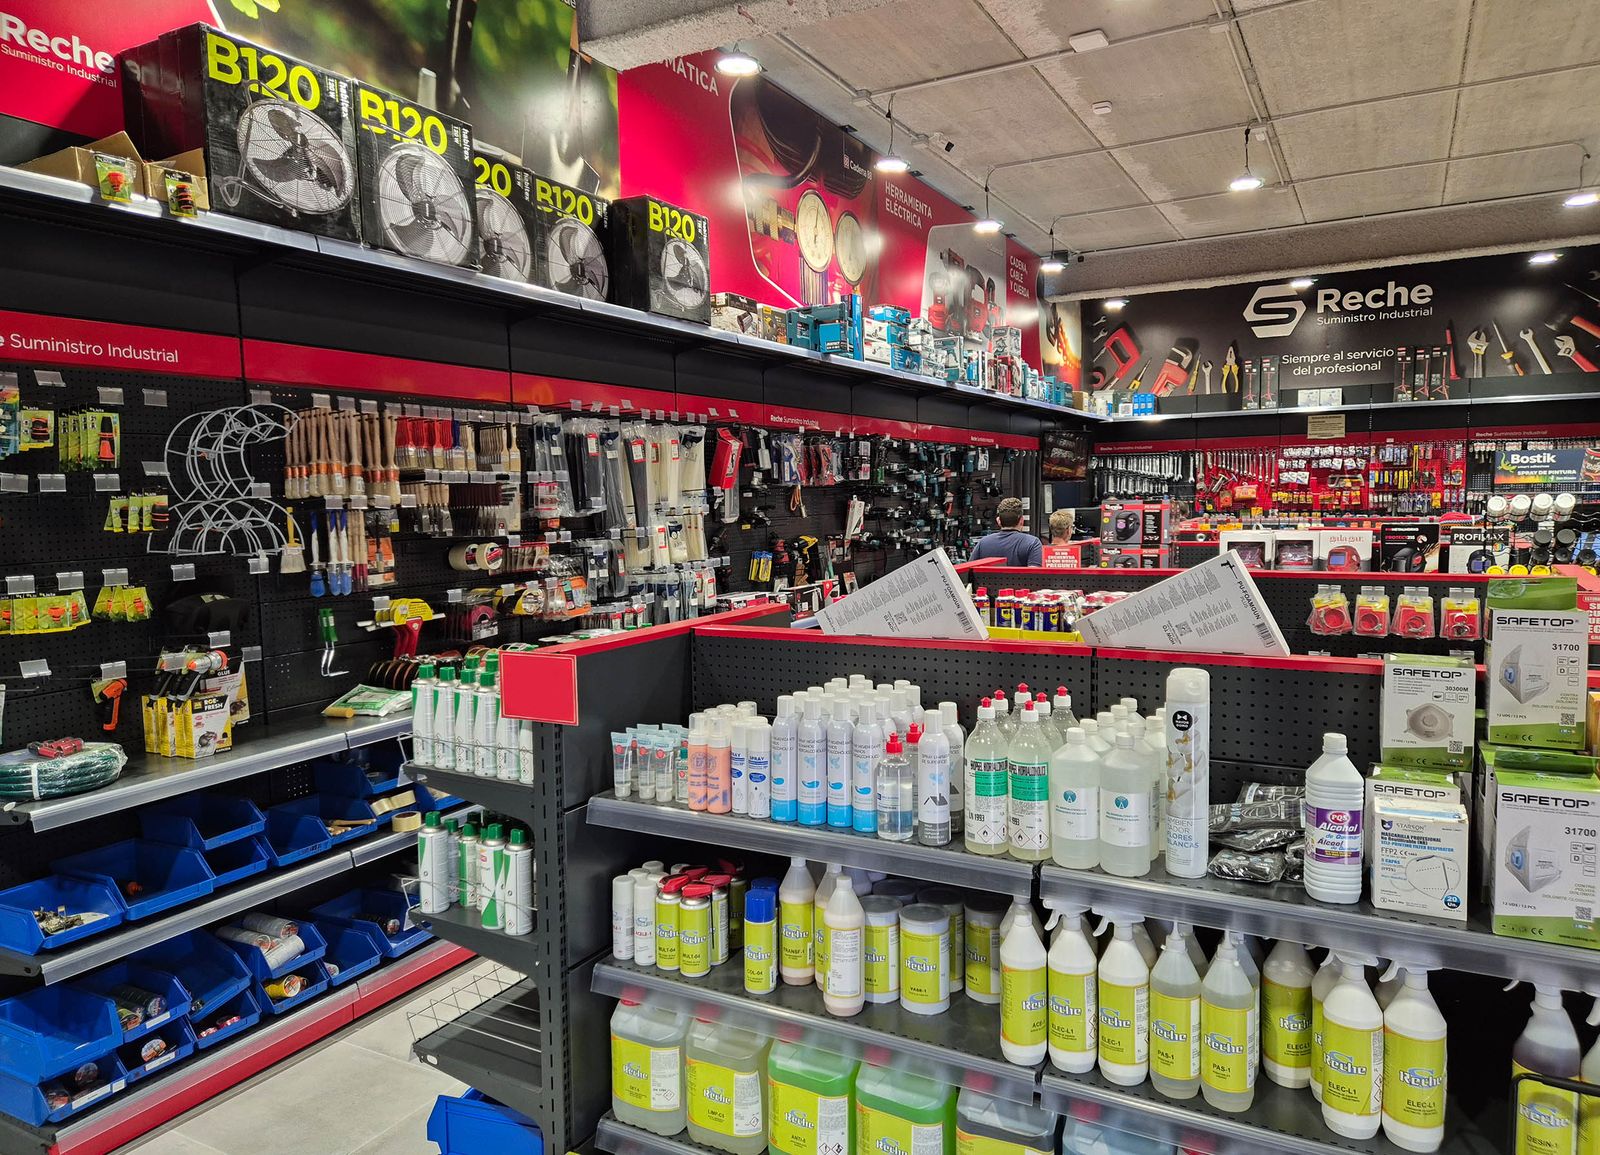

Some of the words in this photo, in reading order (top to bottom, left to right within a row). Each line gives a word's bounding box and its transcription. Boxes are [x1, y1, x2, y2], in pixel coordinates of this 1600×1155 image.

[0, 11, 116, 74] Reche
[1, 43, 65, 72] Suministro
[67, 64, 117, 88] Industrial
[206, 33, 321, 111] B120
[663, 54, 719, 97] MÁTICA
[359, 88, 448, 155] B120
[473, 157, 512, 199] 20
[536, 178, 594, 226] B120
[884, 181, 933, 220] HERRAMIENTA
[649, 201, 696, 243] B120
[884, 198, 924, 230] ELÉCTRICA
[1009, 267, 1025, 284] CABLE
[1316, 281, 1434, 314] Reche
[1316, 312, 1376, 326] Suministro
[1379, 306, 1433, 320] Industrial
[10, 333, 103, 355] Suministro
[108, 343, 179, 363] Industrial
[1281, 352, 1331, 365] Siempre
[1332, 349, 1344, 361] al
[1346, 347, 1395, 361] servicio
[1293, 363, 1311, 377] del
[1313, 360, 1382, 377] profesional
[1510, 452, 1557, 464] Bostik
[1453, 533, 1504, 542] PROFIMAX
[1237, 580, 1261, 620] PU-FOAMGUN
[1496, 616, 1574, 627] SAFETOP
[1551, 643, 1580, 652] 31700
[217, 669, 231, 677] GLUE
[1392, 667, 1463, 679] SAFETOP
[204, 703, 224, 711] FRESH
[1373, 784, 1446, 799] SAFETOP
[1501, 792, 1590, 809] SAFETOP
[1319, 822, 1358, 832] Alcohol
[1564, 826, 1597, 838] 31700
[1380, 847, 1398, 855] FFP2
[905, 959, 937, 973] Reche
[1051, 1023, 1074, 1035] ELEC-L1
[1152, 1021, 1187, 1042] Reche
[1101, 1035, 1121, 1046] ELEC-1
[1204, 1033, 1244, 1055] Reche
[1157, 1049, 1175, 1060] PAS-1
[1212, 1063, 1231, 1073] PAS-1
[1323, 1052, 1368, 1076] Reche
[1328, 1080, 1357, 1095] ELEC-L1
[1399, 1069, 1443, 1090] Reche
[703, 1088, 732, 1105] Reche
[1406, 1098, 1436, 1109] ELEC-L1
[783, 1110, 815, 1130] Reche
[1519, 1102, 1570, 1129] Reche
